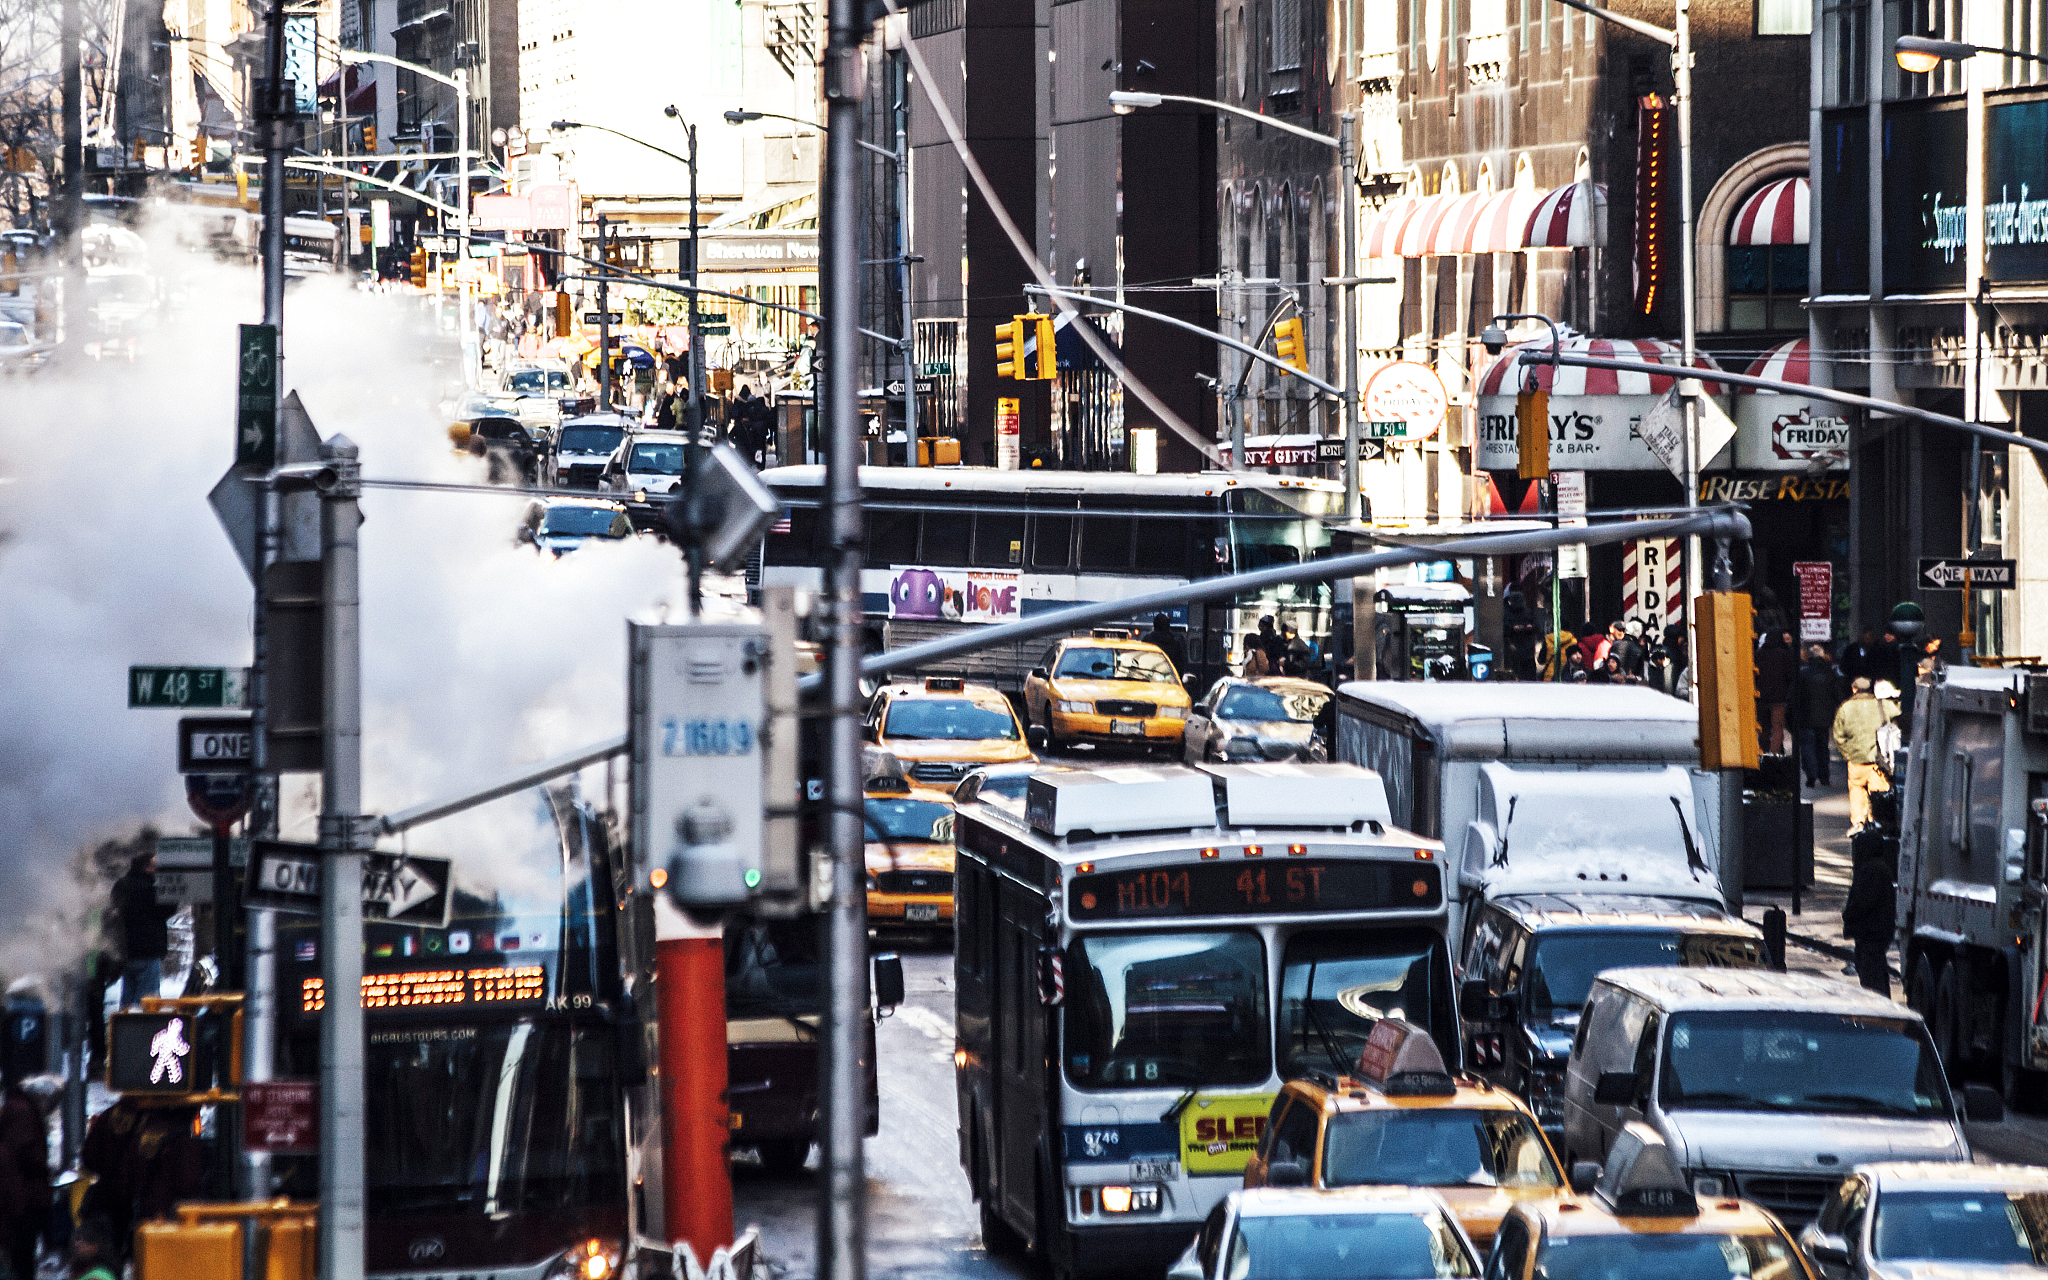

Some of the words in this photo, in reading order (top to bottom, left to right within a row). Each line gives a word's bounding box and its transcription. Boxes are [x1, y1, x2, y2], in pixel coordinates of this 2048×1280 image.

[707, 242, 783, 260] Sheraton
[786, 241, 820, 260] New
[925, 363, 932, 374] W
[934, 363, 941, 374] 51
[1374, 423, 1381, 436] W
[1384, 423, 1395, 436] 50
[1486, 410, 1594, 441] FRIY'S
[1274, 450, 1317, 464] GIFTS
[1556, 443, 1564, 454] &
[1567, 443, 1594, 454] BAR
[1707, 476, 1774, 500] RIESE
[1933, 568, 1960, 580] ONE
[1974, 568, 2003, 580] WAY
[967, 581, 1017, 616] HOME
[1477, 664, 1487, 679] P
[136, 673, 154, 704] W
[162, 673, 189, 704] 48
[198, 673, 216, 689] ST
[204, 736, 252, 758] ONE
[275, 863, 311, 893] ON
[1118, 871, 1191, 911] M104
[1237, 868, 1270, 904] 41
[1286, 867, 1325, 902] ST
[573, 996, 592, 1009] 99
[1084, 1131, 1120, 1145] 6746
